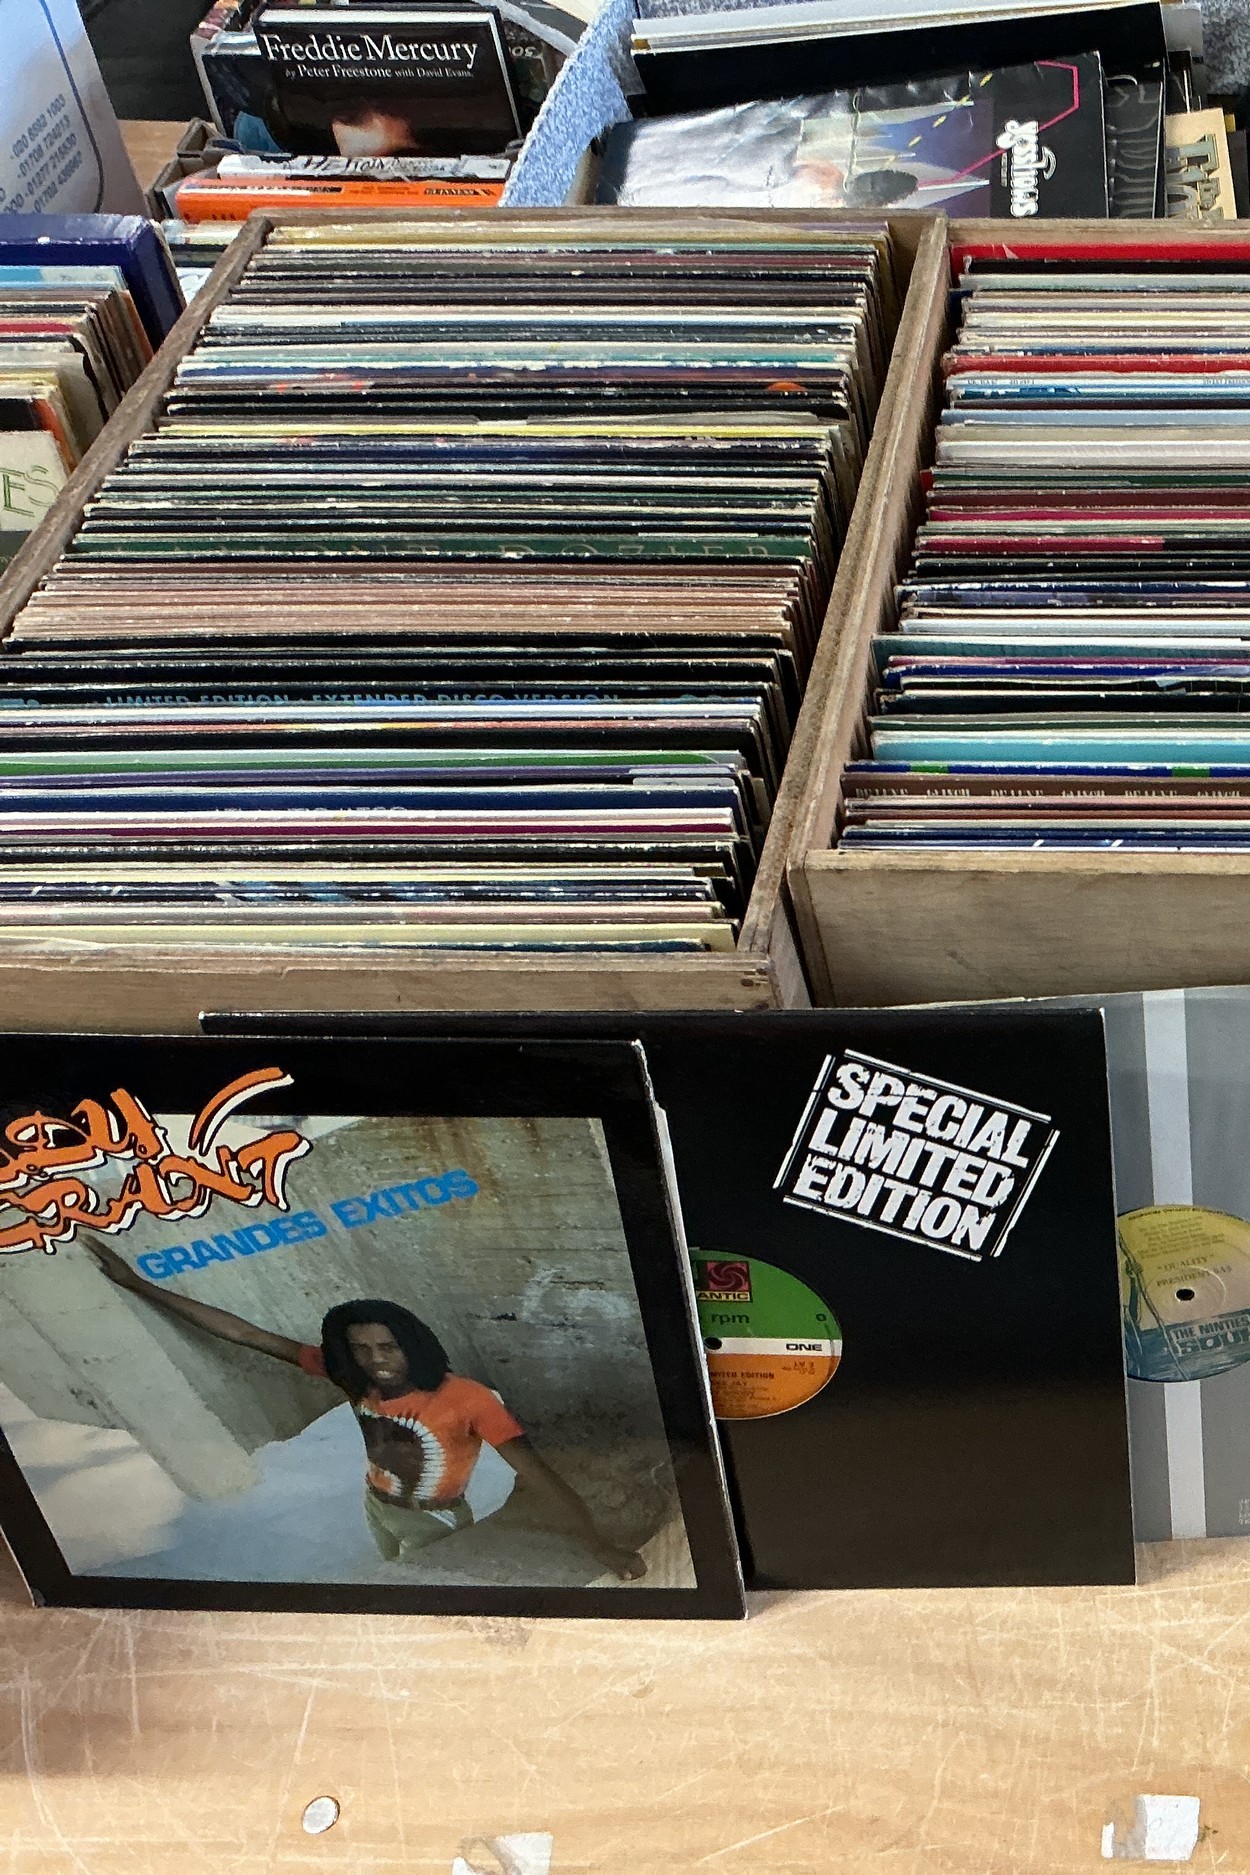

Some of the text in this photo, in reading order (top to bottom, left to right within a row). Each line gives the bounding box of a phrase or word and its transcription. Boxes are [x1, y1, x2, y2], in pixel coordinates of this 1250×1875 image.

[261, 34, 362, 61] Freddie
[360, 34, 478, 69] Mercury
[298, 65, 330, 78] Peter
[332, 64, 392, 78] Freestone
[394, 69, 415, 78] with
[417, 67, 443, 78] David
[828, 1064, 1031, 1168] SPECIAL
[808, 1108, 1015, 1209] LIMITED
[793, 1154, 996, 1251] EDITION
[136, 1168, 479, 1279] GRANDES EXITOS
[697, 1291, 749, 1300] ANTIC
[711, 1313, 750, 1325] rpm
[786, 1343, 823, 1351] ONE
